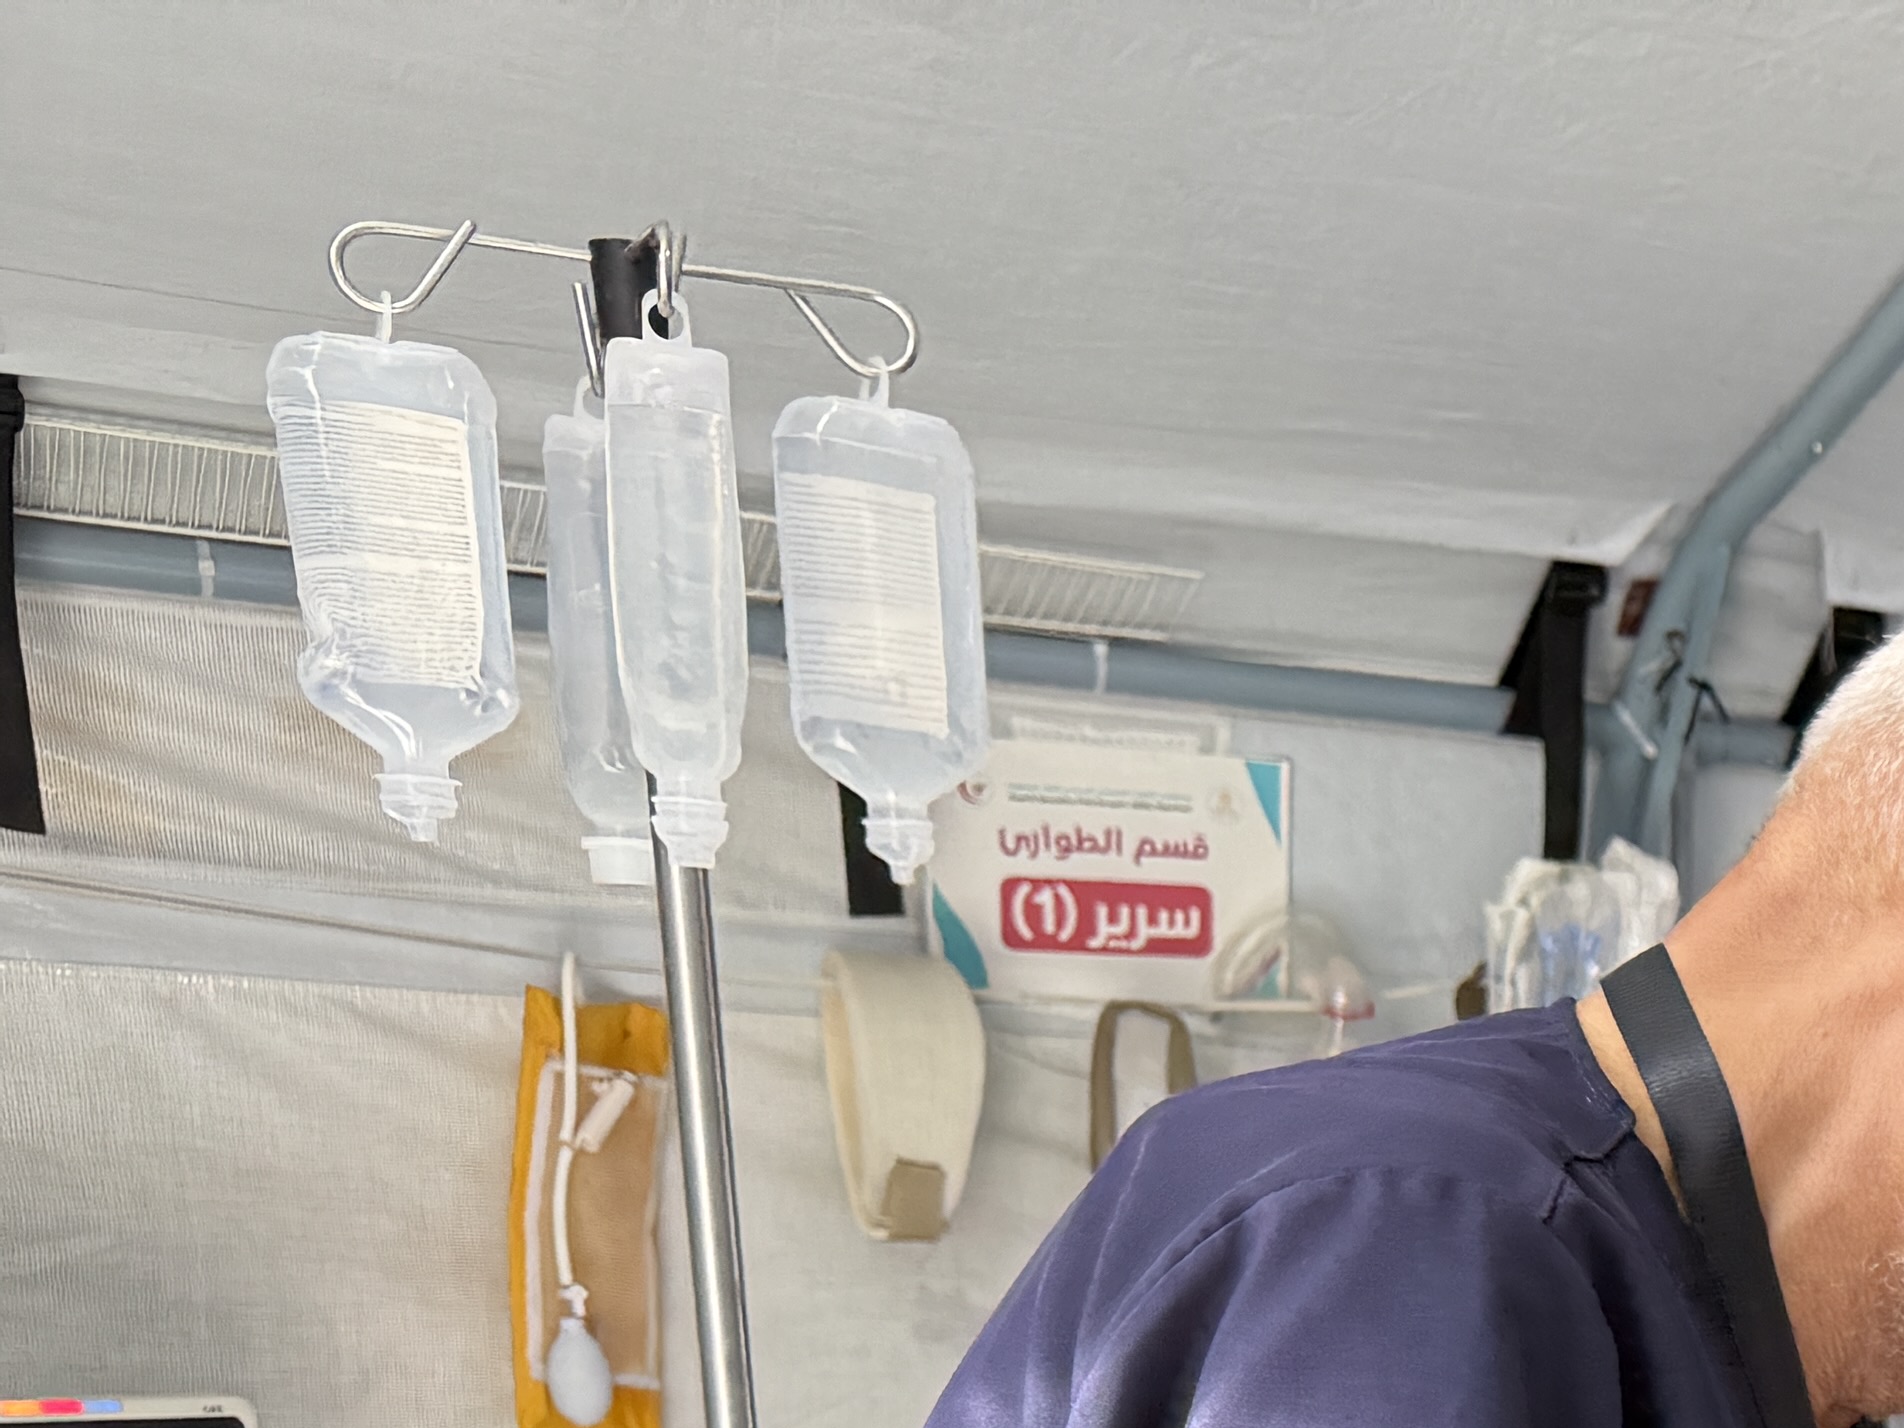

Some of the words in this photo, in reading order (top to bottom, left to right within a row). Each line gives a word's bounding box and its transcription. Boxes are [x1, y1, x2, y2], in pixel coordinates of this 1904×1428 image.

[1133, 830, 1209, 866] قسم
[1010, 880, 1079, 943] (1)
[1085, 900, 1201, 951] سرير
